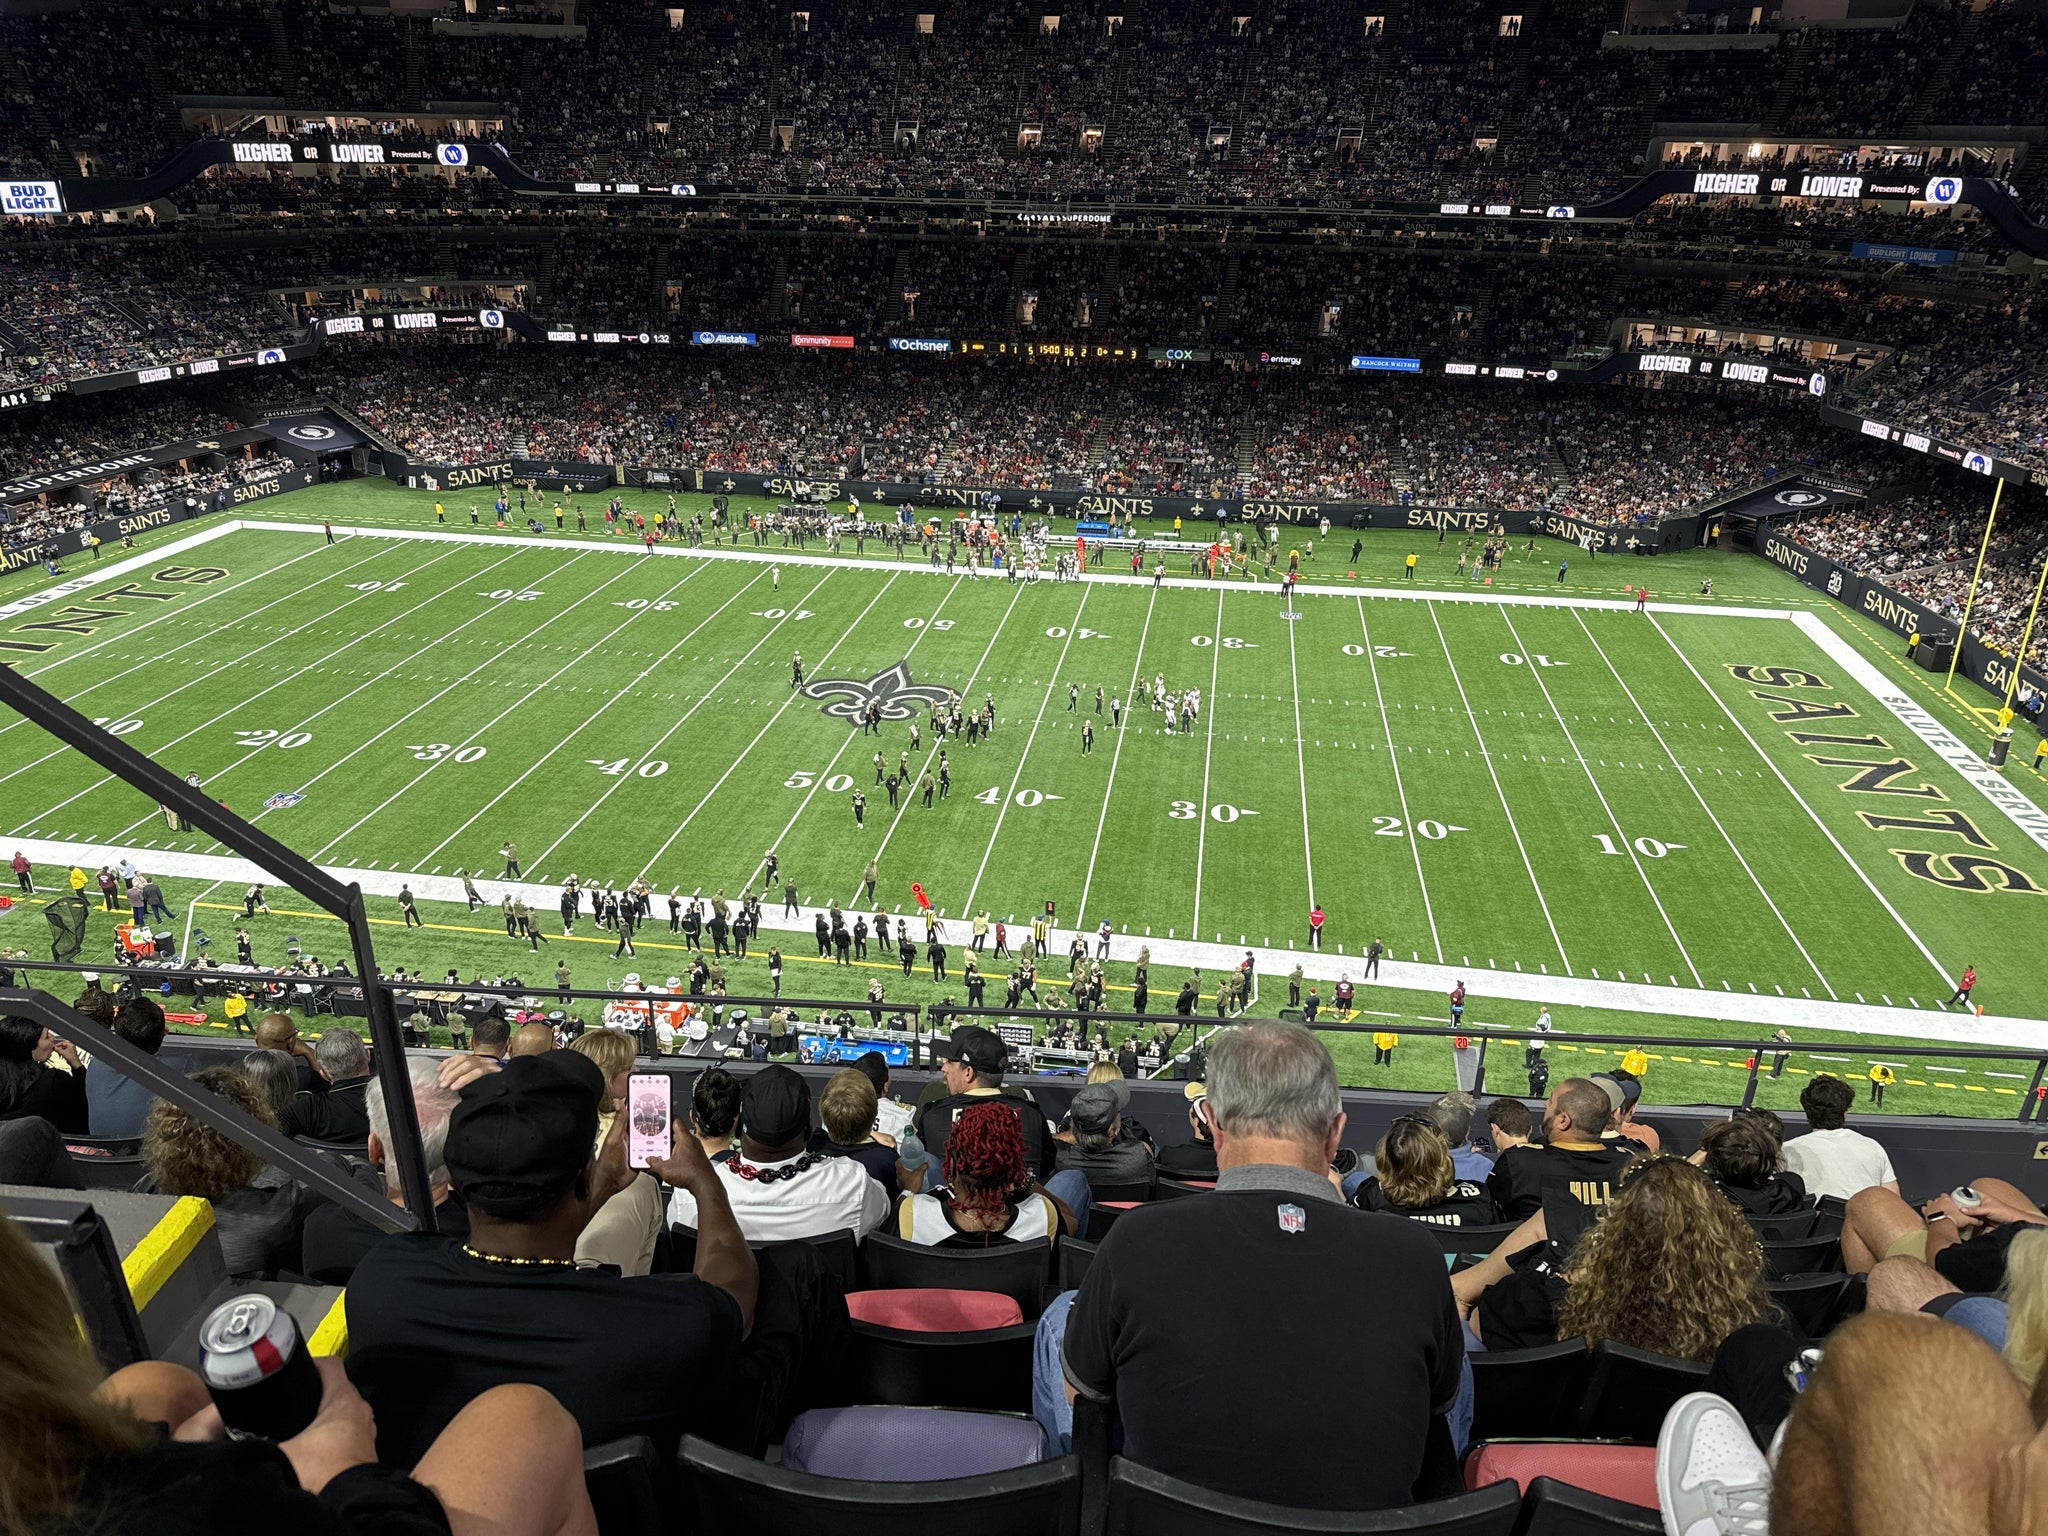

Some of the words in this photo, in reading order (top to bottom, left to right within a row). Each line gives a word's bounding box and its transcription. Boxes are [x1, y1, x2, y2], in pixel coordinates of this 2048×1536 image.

[232, 143, 293, 162] HIGHER
[303, 147, 319, 159] OR
[330, 144, 385, 163] LOWER
[391, 150, 422, 159] Presented
[10, 185, 47, 197] BUD
[756, 185, 788, 194] SAINTS
[1694, 173, 1760, 195] HIGHER
[1770, 178, 1788, 192] OR
[1800, 175, 1863, 198] LOWER
[1869, 183, 1901, 194] Presented
[1901, 184, 1920, 195] By:
[826, 187, 857, 196] SAINTS
[894, 189, 926, 198] SAINTS
[964, 191, 996, 200] SAINTS
[7, 197, 55, 209] LIGHT
[1105, 194, 1137, 203] SAINTS
[1175, 196, 1207, 205] SAINTS
[1245, 198, 1279, 207] SAINTS
[230, 203, 262, 212] SAINTS
[300, 202, 332, 210] SAINTS
[370, 201, 402, 209] SAINTS
[441, 201, 474, 210] SAINTS
[509, 201, 541, 210] SAINTS
[578, 202, 608, 210] SAINTS
[643, 203, 673, 212] SAINTS
[708, 205, 738, 213] SAINTS
[1318, 200, 1352, 209] SAINTS
[772, 206, 801, 215] SAINTS
[836, 207, 865, 216] SAINTS
[899, 209, 928, 218] SAINTS
[962, 211, 991, 220] SAINTS
[1062, 214, 1112, 223] SUPERDOME
[1137, 215, 1167, 224] SAINTS
[1203, 217, 1233, 226] SAINTS
[1267, 218, 1298, 228] SAINTS
[1335, 221, 1367, 230] SAINTS
[1404, 223, 1437, 232] SAINTS
[1475, 225, 1509, 234] SAINTS
[1549, 228, 1583, 238] SAINTS
[1624, 230, 1659, 241] SAINTS
[1700, 234, 1735, 244] SAINTS
[1777, 238, 1812, 249] SAINTS
[1869, 248, 1885, 257] BUD
[1885, 249, 1907, 259] LIGHT
[1909, 250, 1938, 262] LOUNGE
[325, 316, 364, 335] HIGHER
[372, 318, 384, 328] OR
[393, 313, 437, 329] LOWER
[548, 332, 576, 342] HIGHER
[594, 333, 620, 343] LOWER
[653, 334, 669, 343] 1:32
[715, 335, 748, 344] Allstate
[759, 334, 789, 343] SAINTS
[794, 335, 832, 347] Community
[899, 339, 949, 351] Ochsner
[962, 344, 968, 353] 3
[1000, 344, 1006, 352] 0
[1028, 346, 1034, 355] 5
[1039, 345, 1060, 354] 15:00
[1064, 347, 1074, 357] 36
[1081, 348, 1087, 357] 2
[1131, 350, 1137, 359] 3
[1165, 349, 1192, 360] COX
[1213, 351, 1245, 360] SAINTS
[1270, 355, 1301, 366] entergy
[1361, 359, 1389, 367] HANCOCK
[1390, 361, 1420, 369] WHITNEY
[138, 366, 172, 384] HIGHER
[176, 366, 185, 376] OR
[190, 359, 219, 375] LOWER
[1445, 363, 1477, 375] HIGHER
[1495, 366, 1524, 379] LOWER
[1638, 354, 1692, 374] HIGHER
[1699, 362, 1713, 373] OR
[1722, 361, 1769, 383] LOWER
[1772, 373, 1798, 384] Presented
[33, 381, 68, 396] SAINTS
[294, 406, 325, 415] SUPERDOME
[1903, 432, 1931, 453] LOWER
[3, 454, 154, 494] SUPERDOME
[447, 463, 513, 487] SAINTS
[233, 478, 280, 502] SAINTS
[1802, 476, 1831, 488] CAESARS
[1830, 482, 1864, 495] SUPERDOME
[1079, 495, 1154, 516] SAINTS
[118, 508, 171, 535] SAINTS
[1408, 508, 1489, 530] SAINTS
[1546, 517, 1606, 549] SAINTS
[1765, 538, 1809, 575] SAINTS
[356, 580, 410, 593] 10
[1828, 572, 1843, 591] 20
[17, 594, 53, 606] OF
[55, 580, 95, 591] US
[489, 588, 546, 602] 20
[624, 598, 680, 611] 30
[762, 608, 817, 621] 40
[1864, 589, 1919, 634] SAINTS
[903, 617, 957, 631] 50
[1046, 626, 1098, 640] 40
[1191, 635, 1245, 649] 30
[1342, 643, 1399, 658] 20
[1499, 653, 1557, 668] 10
[235, 729, 313, 749] 20
[1883, 696, 1961, 749] SALUTE
[1947, 753, 1988, 773] TO
[413, 742, 487, 764] 30
[598, 758, 670, 778] 40
[783, 770, 854, 793] 50
[1722, 663, 2048, 895] SAINTS
[974, 786, 1043, 807] 40
[269, 798, 292, 808] NFL
[1168, 800, 1239, 823] 30
[1371, 816, 1448, 840] 20
[1591, 834, 1667, 859] 10
[1457, 1037, 1468, 1048] 20
[1282, 1214, 1303, 1228] NFL
